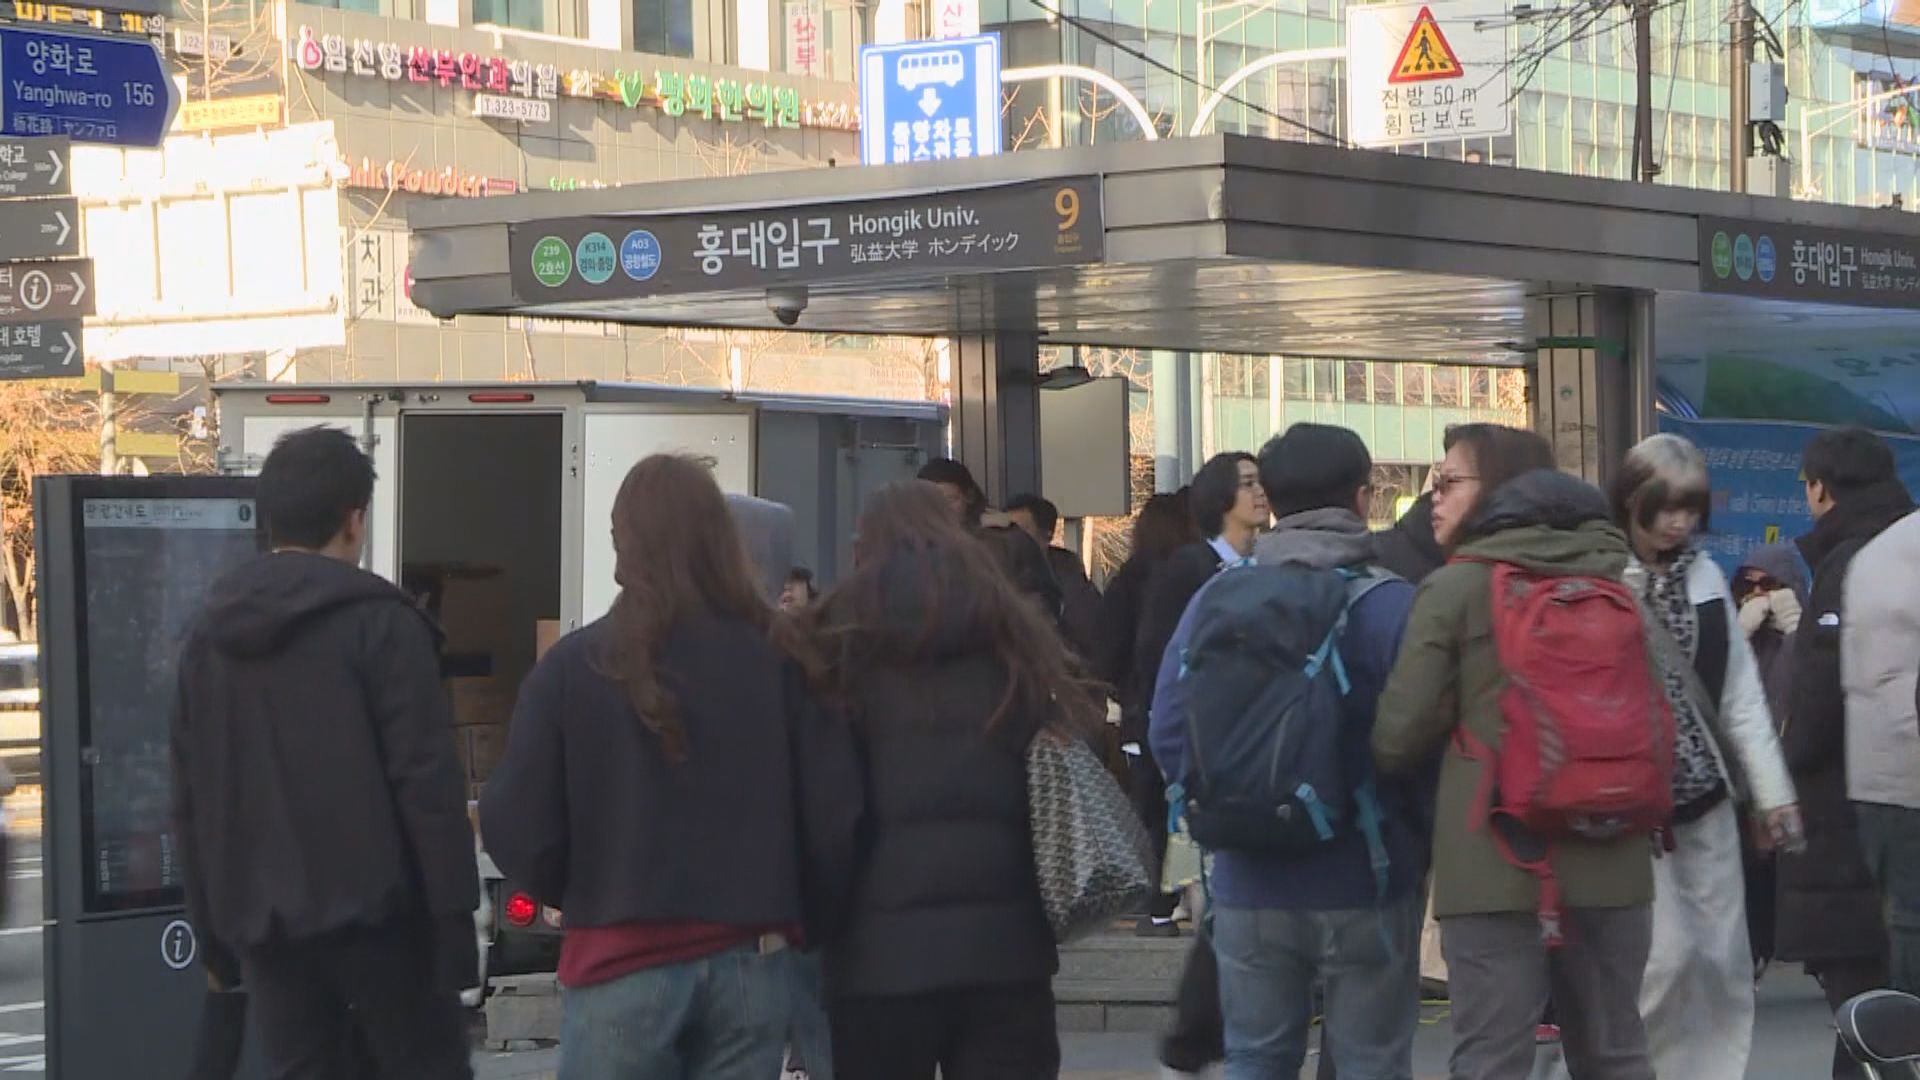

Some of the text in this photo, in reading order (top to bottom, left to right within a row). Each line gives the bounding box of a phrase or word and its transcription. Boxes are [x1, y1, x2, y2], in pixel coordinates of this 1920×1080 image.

[26, 41, 98, 75] 양화로
[13, 80, 154, 107] Yanghwa-ro 156
[1381, 86, 1424, 109] 전방
[1384, 108, 1477, 136] 횡단보도
[849, 206, 980, 237] Hongik Univ.
[1055, 187, 1080, 231] 9
[631, 239, 649, 250] A03
[693, 218, 840, 275] 홍대입구
[850, 239, 919, 264] 弘益大学
[360, 234, 384, 314] 치과
[1791, 239, 1857, 288] 홍대입구
